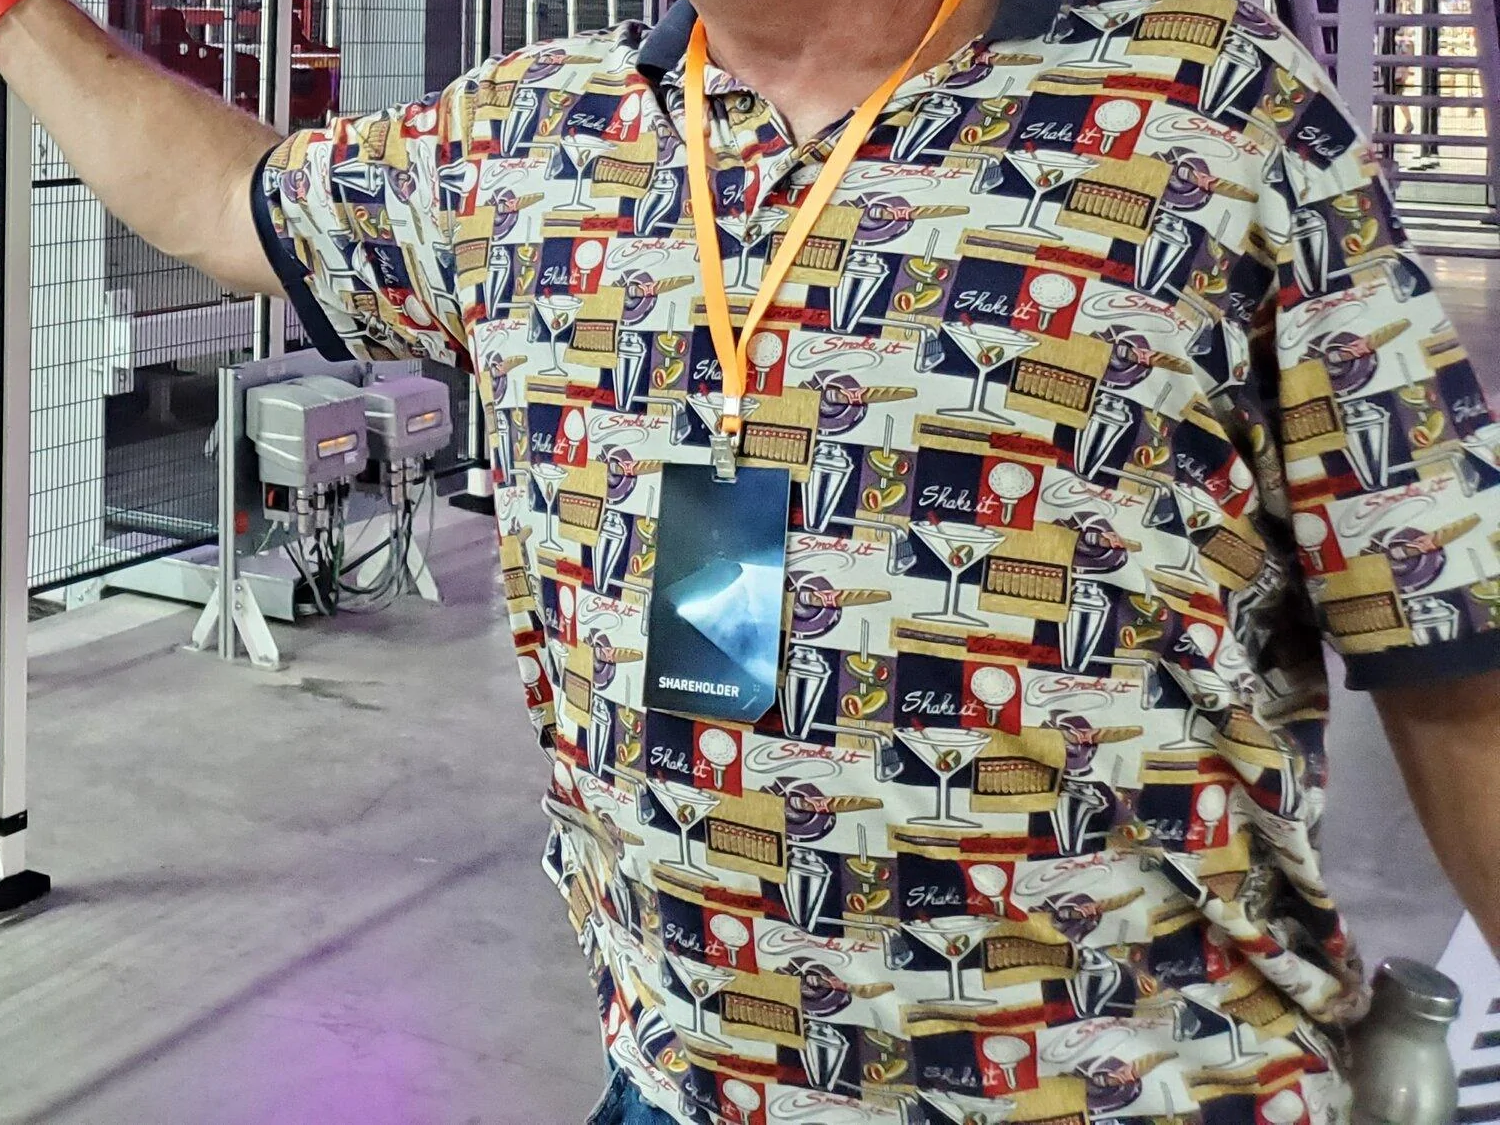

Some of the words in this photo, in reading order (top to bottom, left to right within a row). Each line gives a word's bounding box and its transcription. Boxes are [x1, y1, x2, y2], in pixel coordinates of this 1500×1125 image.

[1019, 121, 1076, 143] Shake
[1074, 126, 1102, 145] it
[1172, 117, 1239, 146] Smoke
[1239, 138, 1266, 156] it
[861, 164, 936, 179] Smoke
[938, 165, 974, 179] it
[954, 290, 1010, 316] Shake
[1011, 301, 1038, 320] it
[810, 336, 876, 356] Smoke
[884, 341, 914, 355] it
[693, 359, 723, 381] Sha
[600, 414, 646, 430] Smoke
[647, 417, 669, 430] it
[918, 485, 974, 512] Shake
[974, 495, 999, 514] it
[787, 535, 849, 554] Smoke
[852, 543, 886, 557] it
[586, 597, 619, 613] Smoke
[619, 604, 641, 618] it
[658, 676, 740, 698] SHAREHOLDER
[1039, 676, 1107, 694] Smoke
[1107, 678, 1140, 694] it
[901, 690, 956, 716] Shake
[956, 701, 985, 717] it
[650, 746, 691, 775] Shake
[691, 760, 712, 778] it
[766, 742, 835, 761] Smoke
[836, 750, 872, 765] it
[906, 885, 961, 908] Shake
[664, 923, 703, 953] Shake
[703, 939, 725, 957] it
